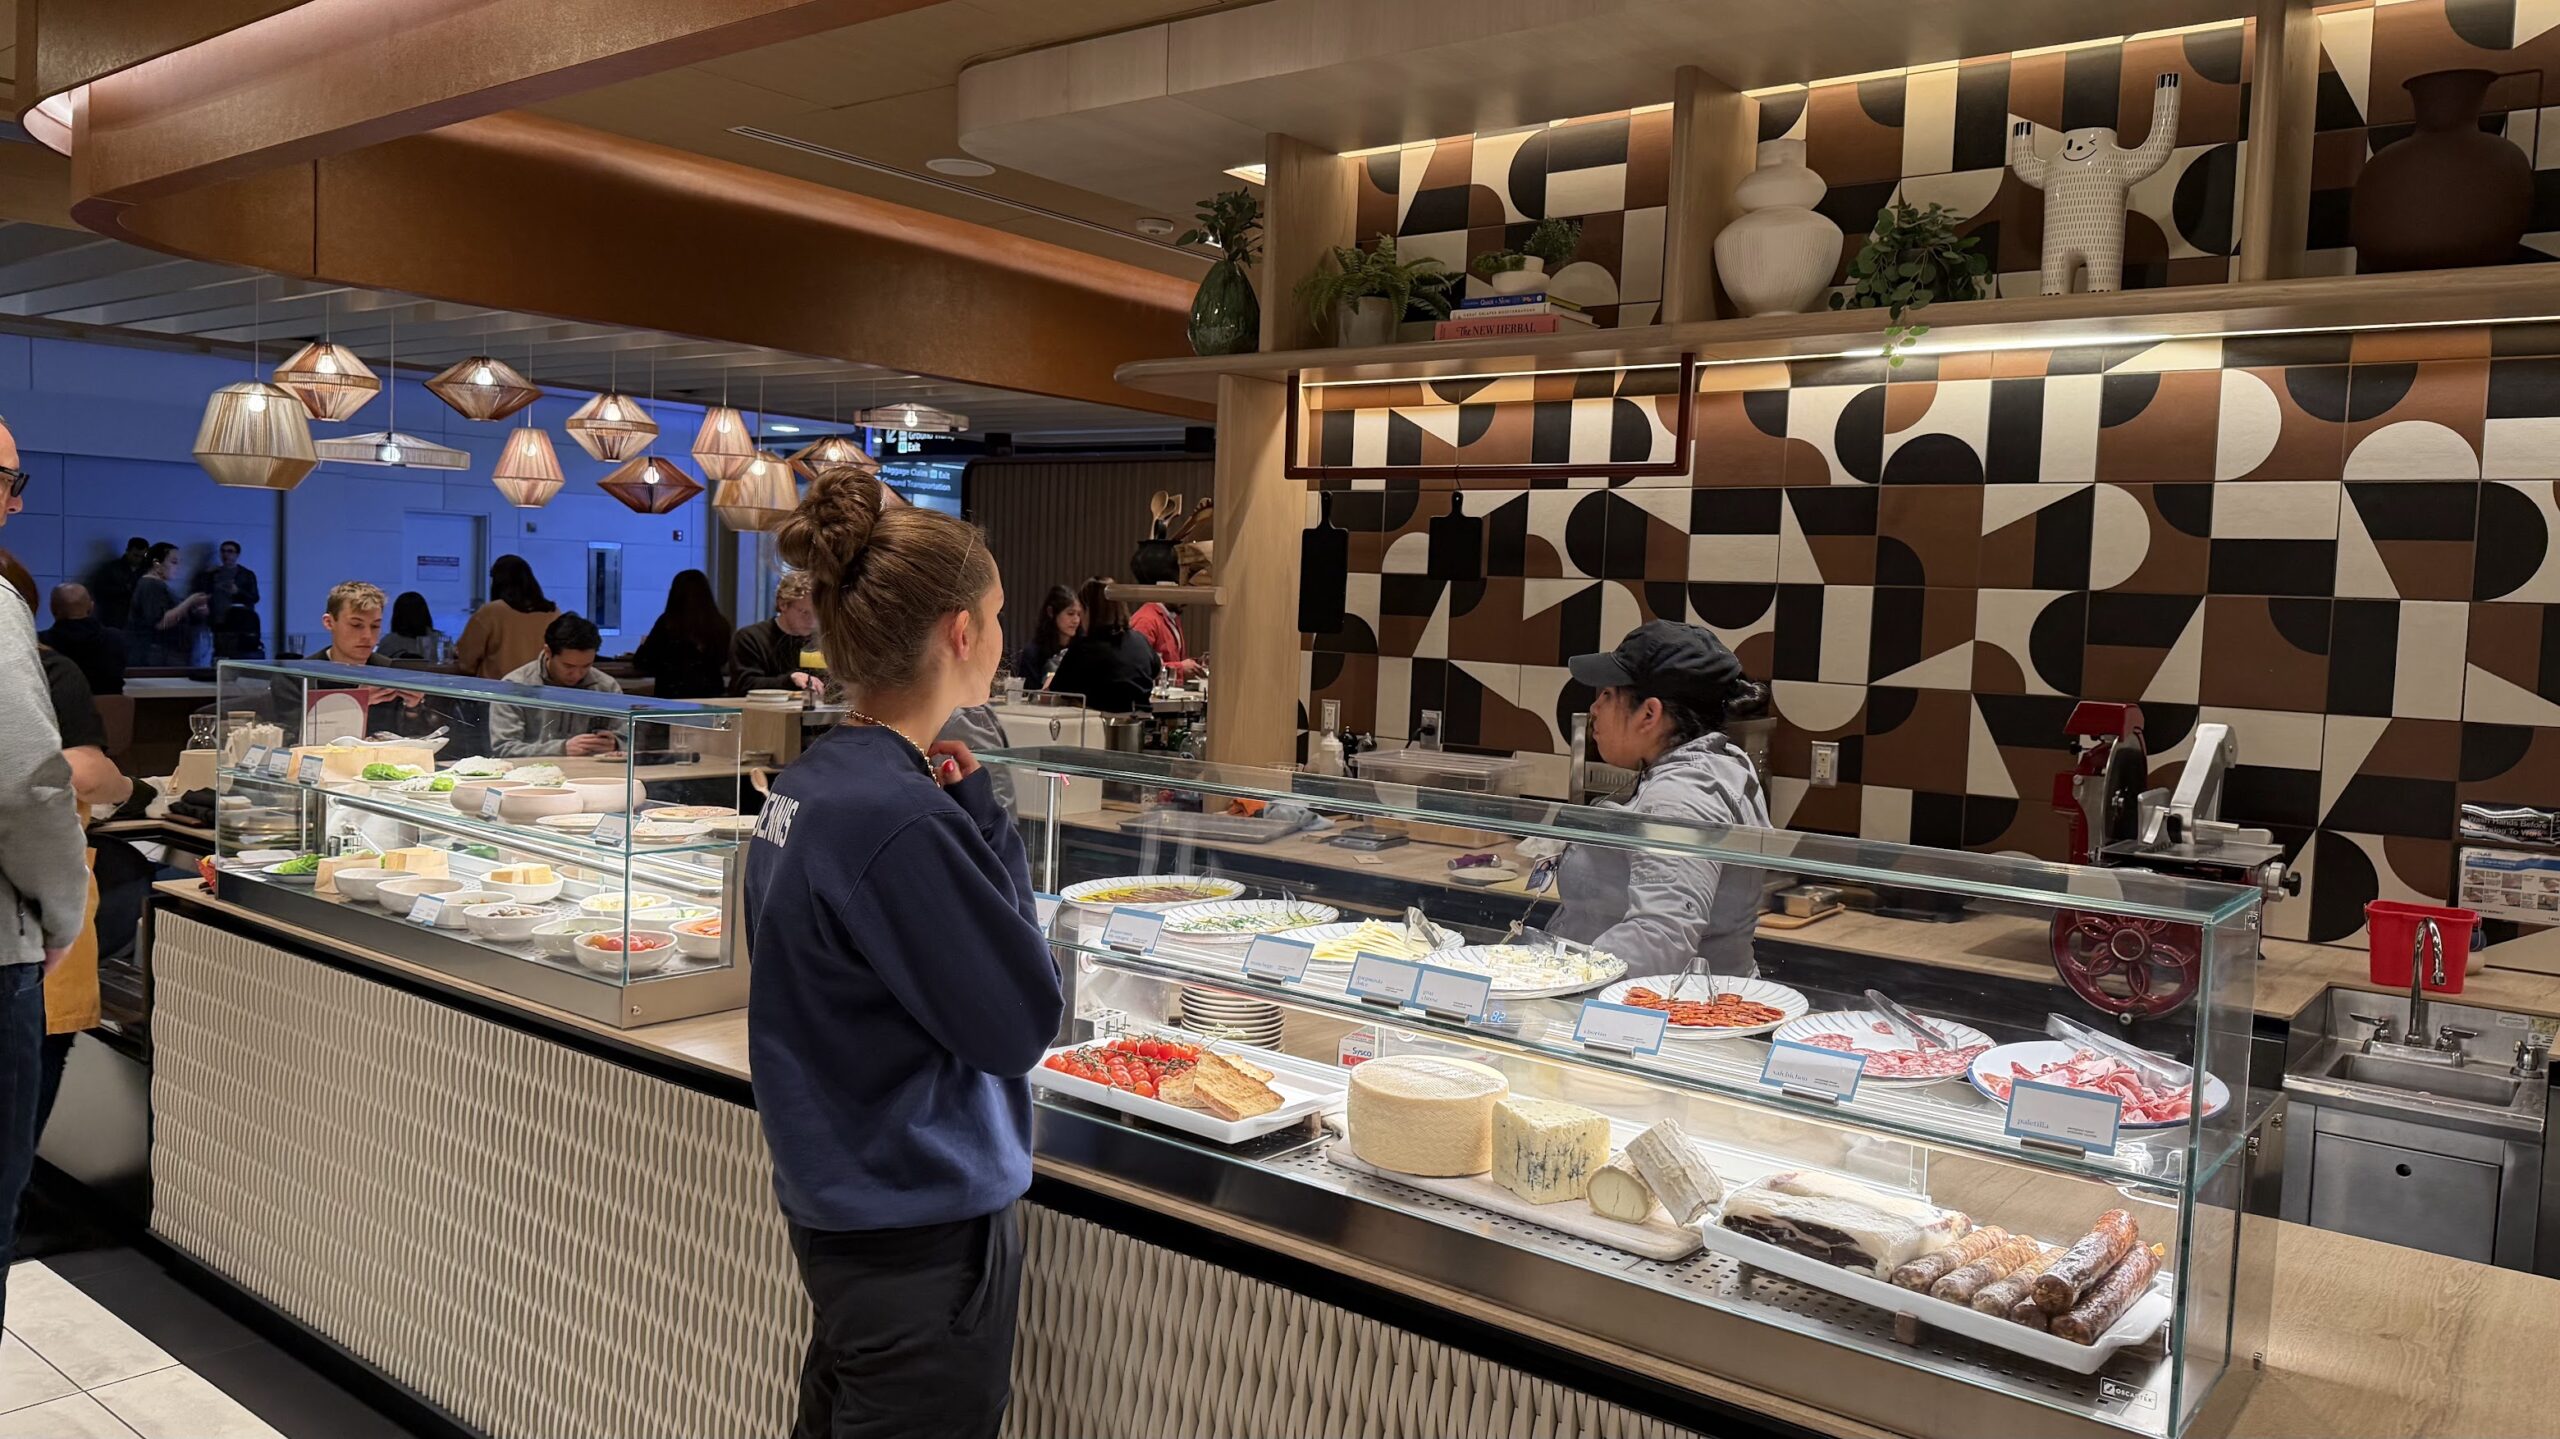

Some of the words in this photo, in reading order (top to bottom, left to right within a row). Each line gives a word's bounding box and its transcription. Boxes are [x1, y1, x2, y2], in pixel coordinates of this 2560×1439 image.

[1456, 325, 1471, 337] The
[1471, 324, 1496, 336] NEW
[1496, 322, 1536, 335] HERBAL
[908, 442, 921, 452] Exit
[882, 464, 909, 477] Baggage
[910, 468, 928, 476] Claim
[938, 471, 950, 480] Exit
[907, 480, 951, 491] Transportation
[2468, 814, 2491, 825] Wash
[2494, 817, 2519, 827] Hands
[2520, 819, 2548, 829] Before
[2509, 828, 2519, 836] To
[1353, 1047, 1372, 1057] Sysco
